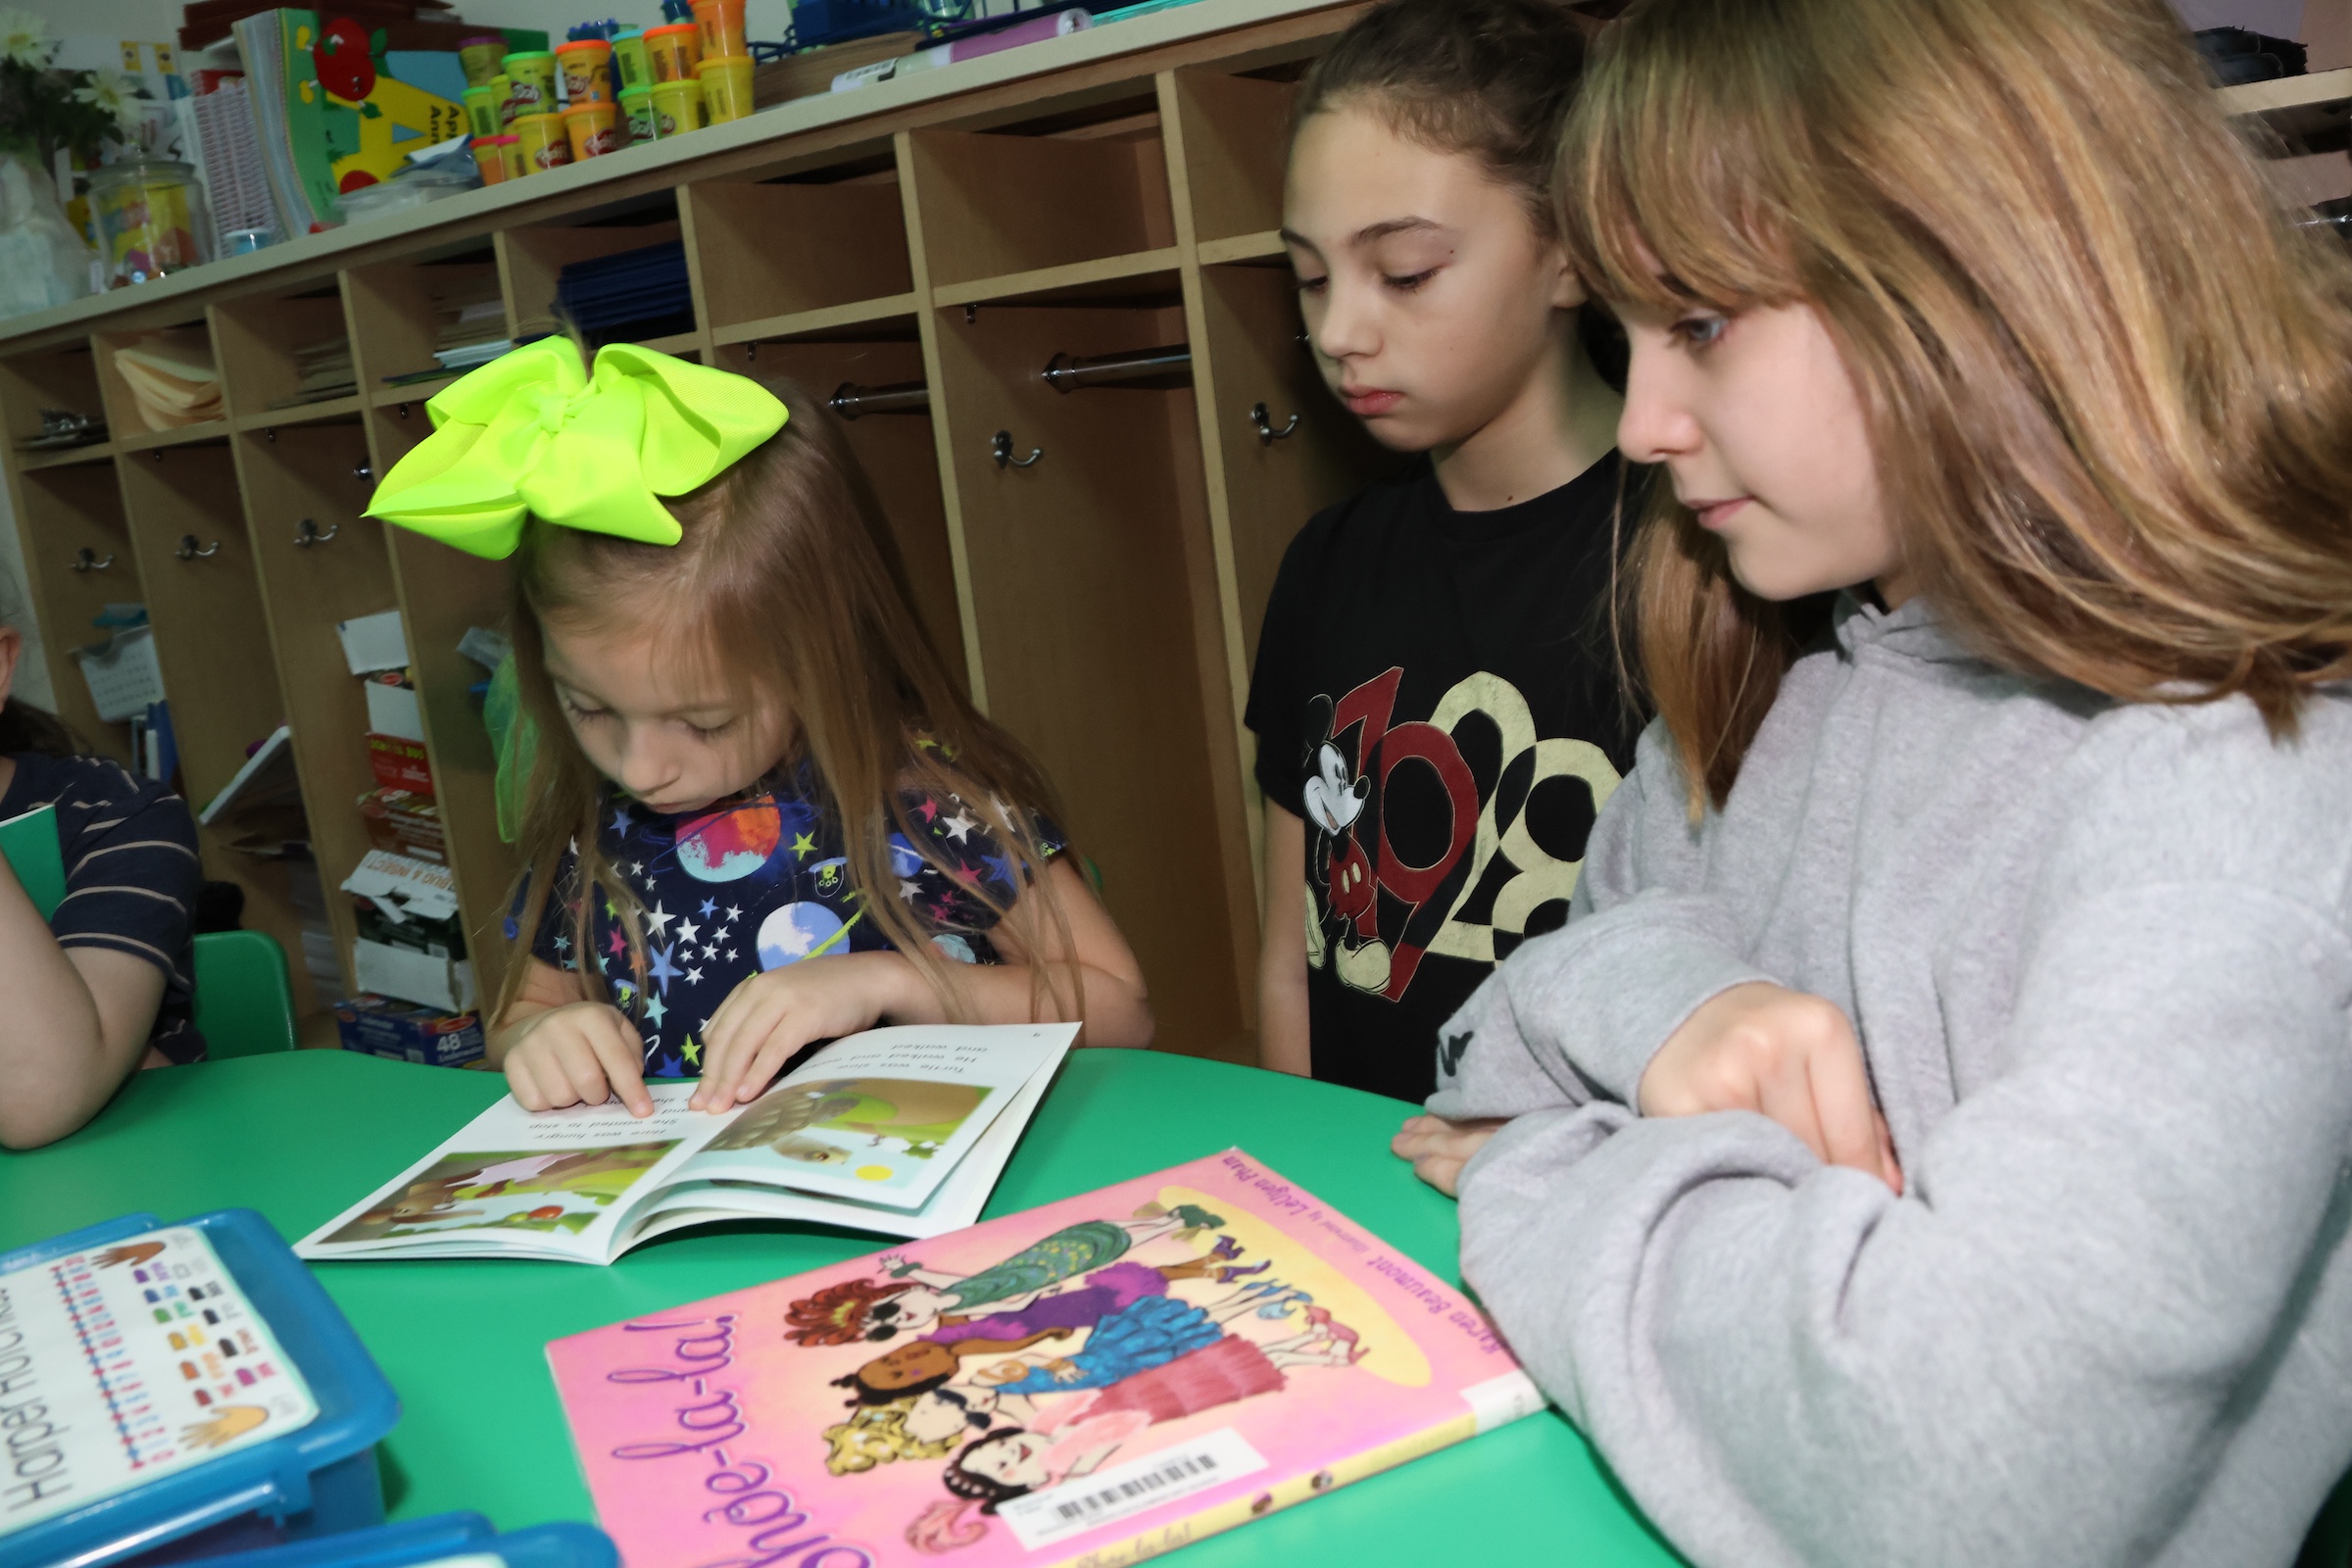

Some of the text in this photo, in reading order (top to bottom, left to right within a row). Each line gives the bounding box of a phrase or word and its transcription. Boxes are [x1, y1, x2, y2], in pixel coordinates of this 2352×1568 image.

[436, 1032, 462, 1053] 48
[850, 1052, 882, 1061] and
[888, 1052, 946, 1060] walked
[954, 1055, 978, 1064] He
[588, 1119, 644, 1129] wanted
[652, 1117, 679, 1126] She
[630, 1128, 667, 1137] Hare
[1366, 1255, 1451, 1315] Beaumont
